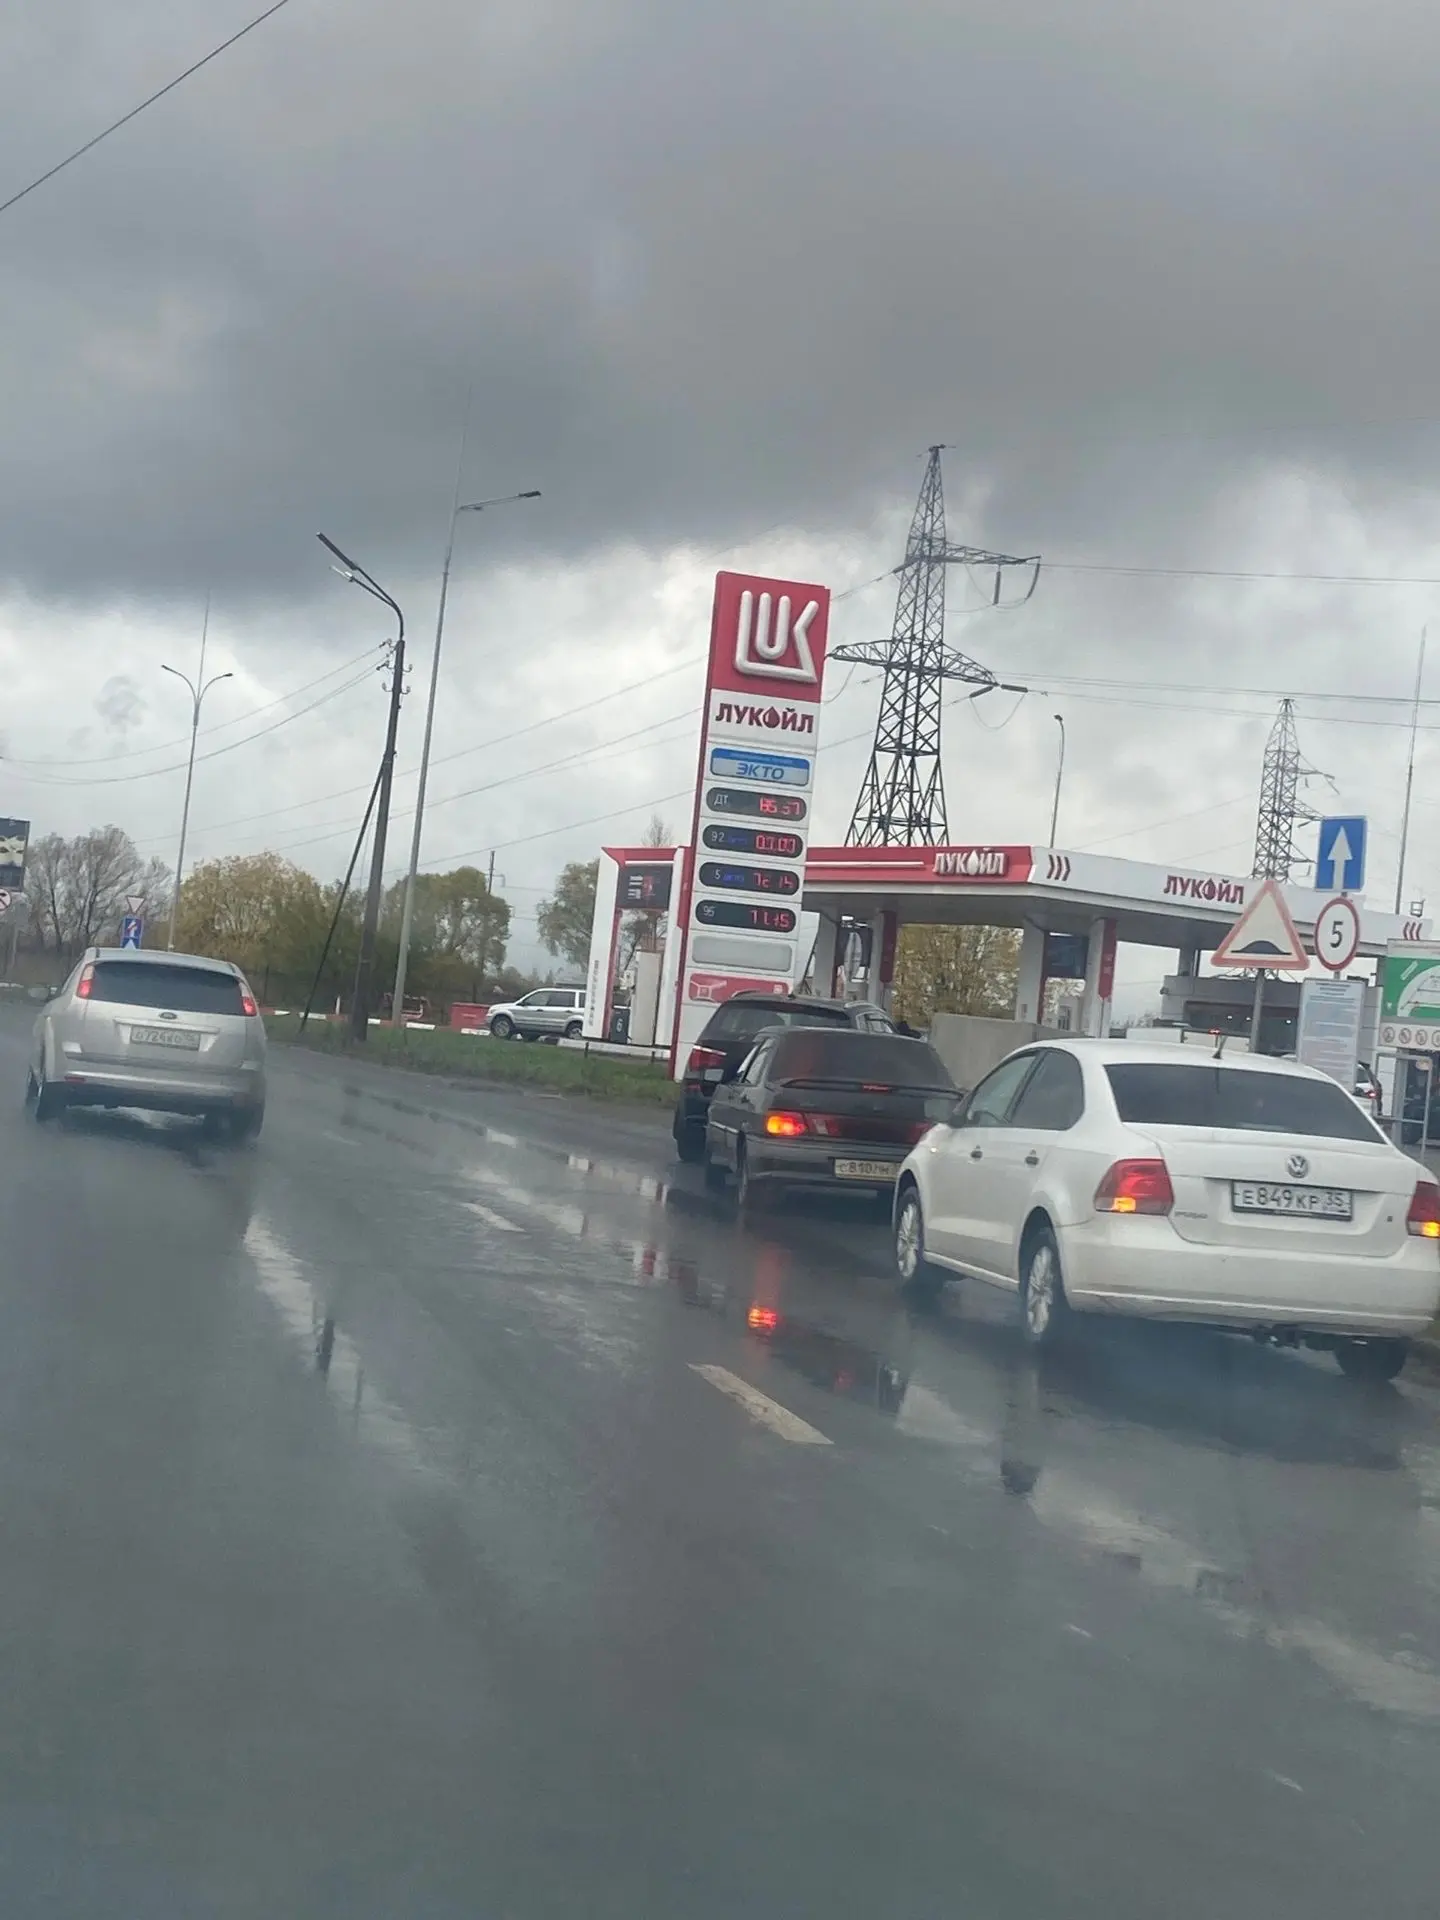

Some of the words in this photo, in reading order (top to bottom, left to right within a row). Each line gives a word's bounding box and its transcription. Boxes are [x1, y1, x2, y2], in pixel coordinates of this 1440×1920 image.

[715, 702, 814, 734] ЛУКОЙЛ
[735, 761, 785, 780] ЭКТО
[713, 793, 729, 807] ДТ
[711, 830, 725, 843] 92
[932, 847, 1005, 876] ЛУКОЙЛ
[1163, 875, 1244, 905] ЛУКОЙЛ
[703, 904, 716, 917] 95
[1330, 920, 1344, 949] 5
[1243, 1186, 1321, 1210] Е849КР
[1325, 1191, 1344, 1207] 35
